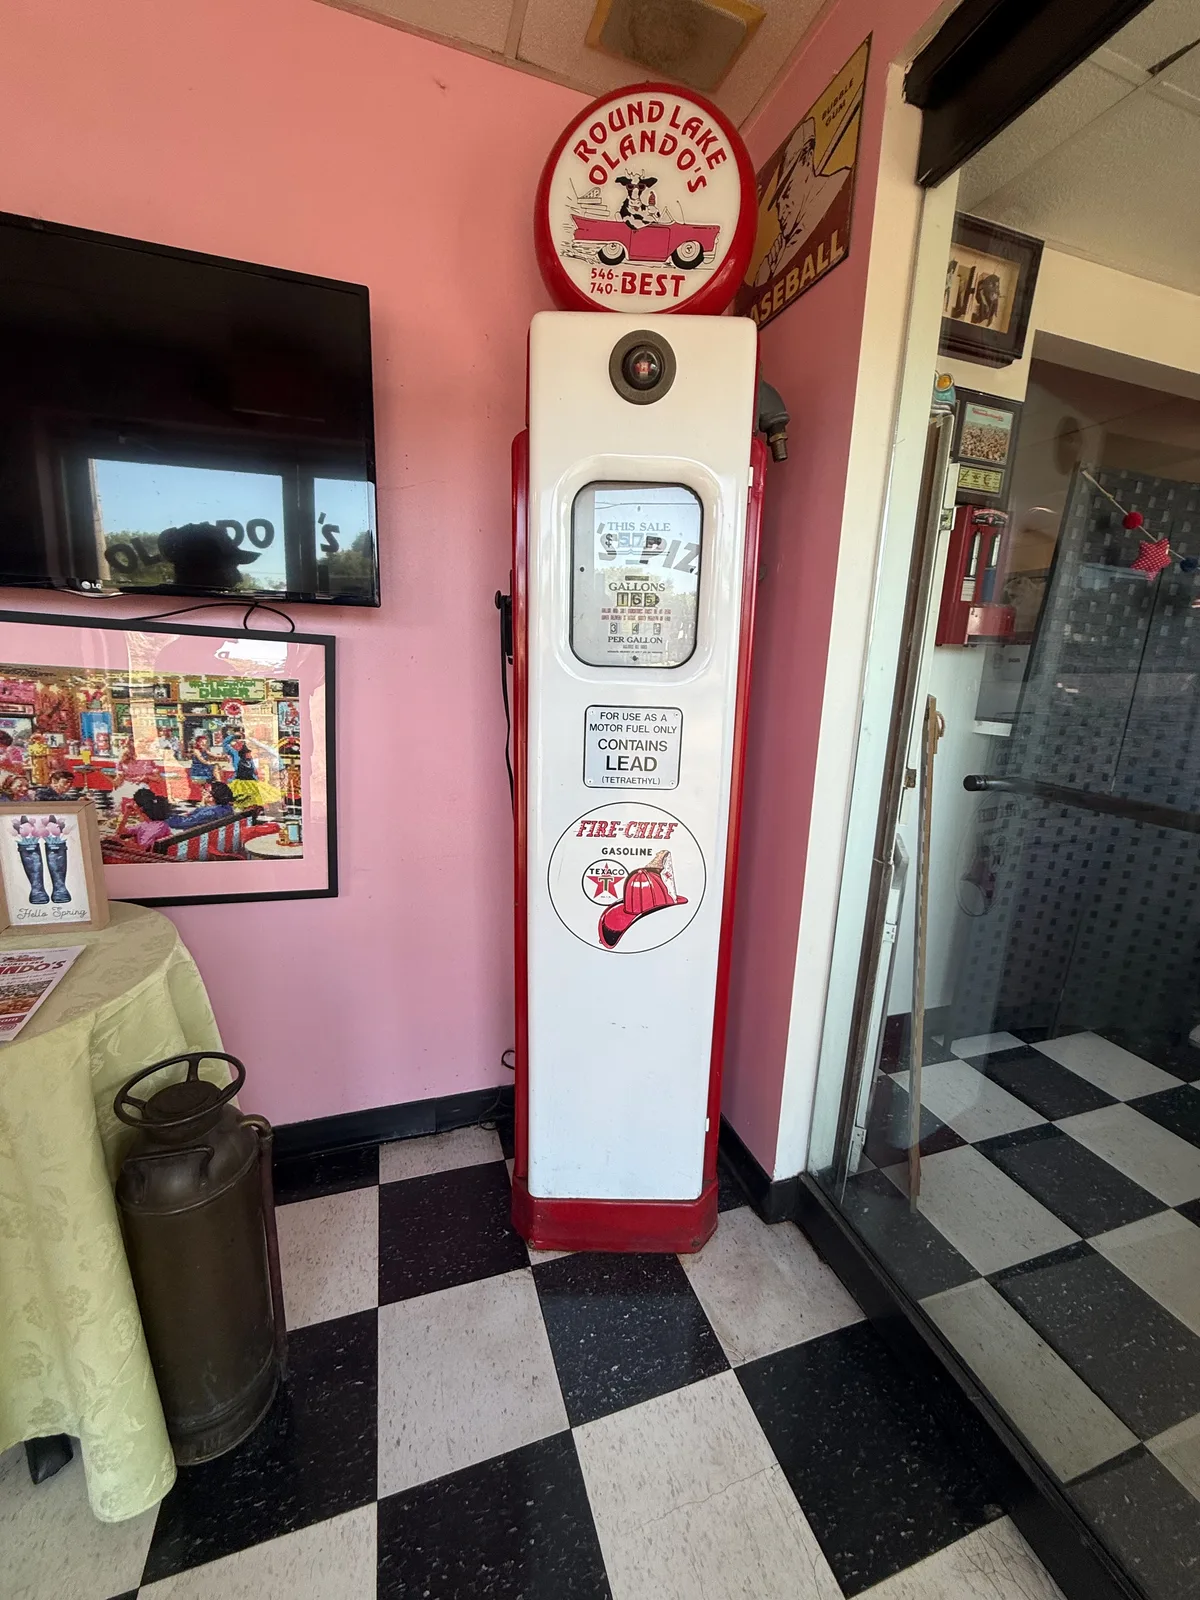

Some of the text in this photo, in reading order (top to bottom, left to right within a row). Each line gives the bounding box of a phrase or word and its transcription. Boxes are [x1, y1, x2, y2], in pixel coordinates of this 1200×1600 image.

[573, 100, 728, 170] ROUND LAKE
[588, 130, 708, 194] OLANDO'S
[590, 268, 619, 280] 546-
[750, 229, 845, 326] ASEBALL
[590, 282, 618, 294] 740-
[621, 271, 686, 297] BEST
[607, 522, 671, 532] THIS SALE
[608, 583, 666, 592] GALLONS
[627, 636, 663, 644] GALLON
[600, 711, 668, 722] FOR USE AS A
[589, 724, 678, 735] MOTOR FUEL ONLY
[597, 738, 668, 752] CONTAINS
[606, 755, 658, 772] LEAD
[601, 776, 661, 786] (TETRAETHYL)
[574, 820, 679, 840] FIRE-CHIEF
[601, 847, 653, 857] GASOLINE
[590, 868, 626, 876] TEXACO
[598, 877, 614, 891] T
[17, 907, 88, 920] Hello Spring
